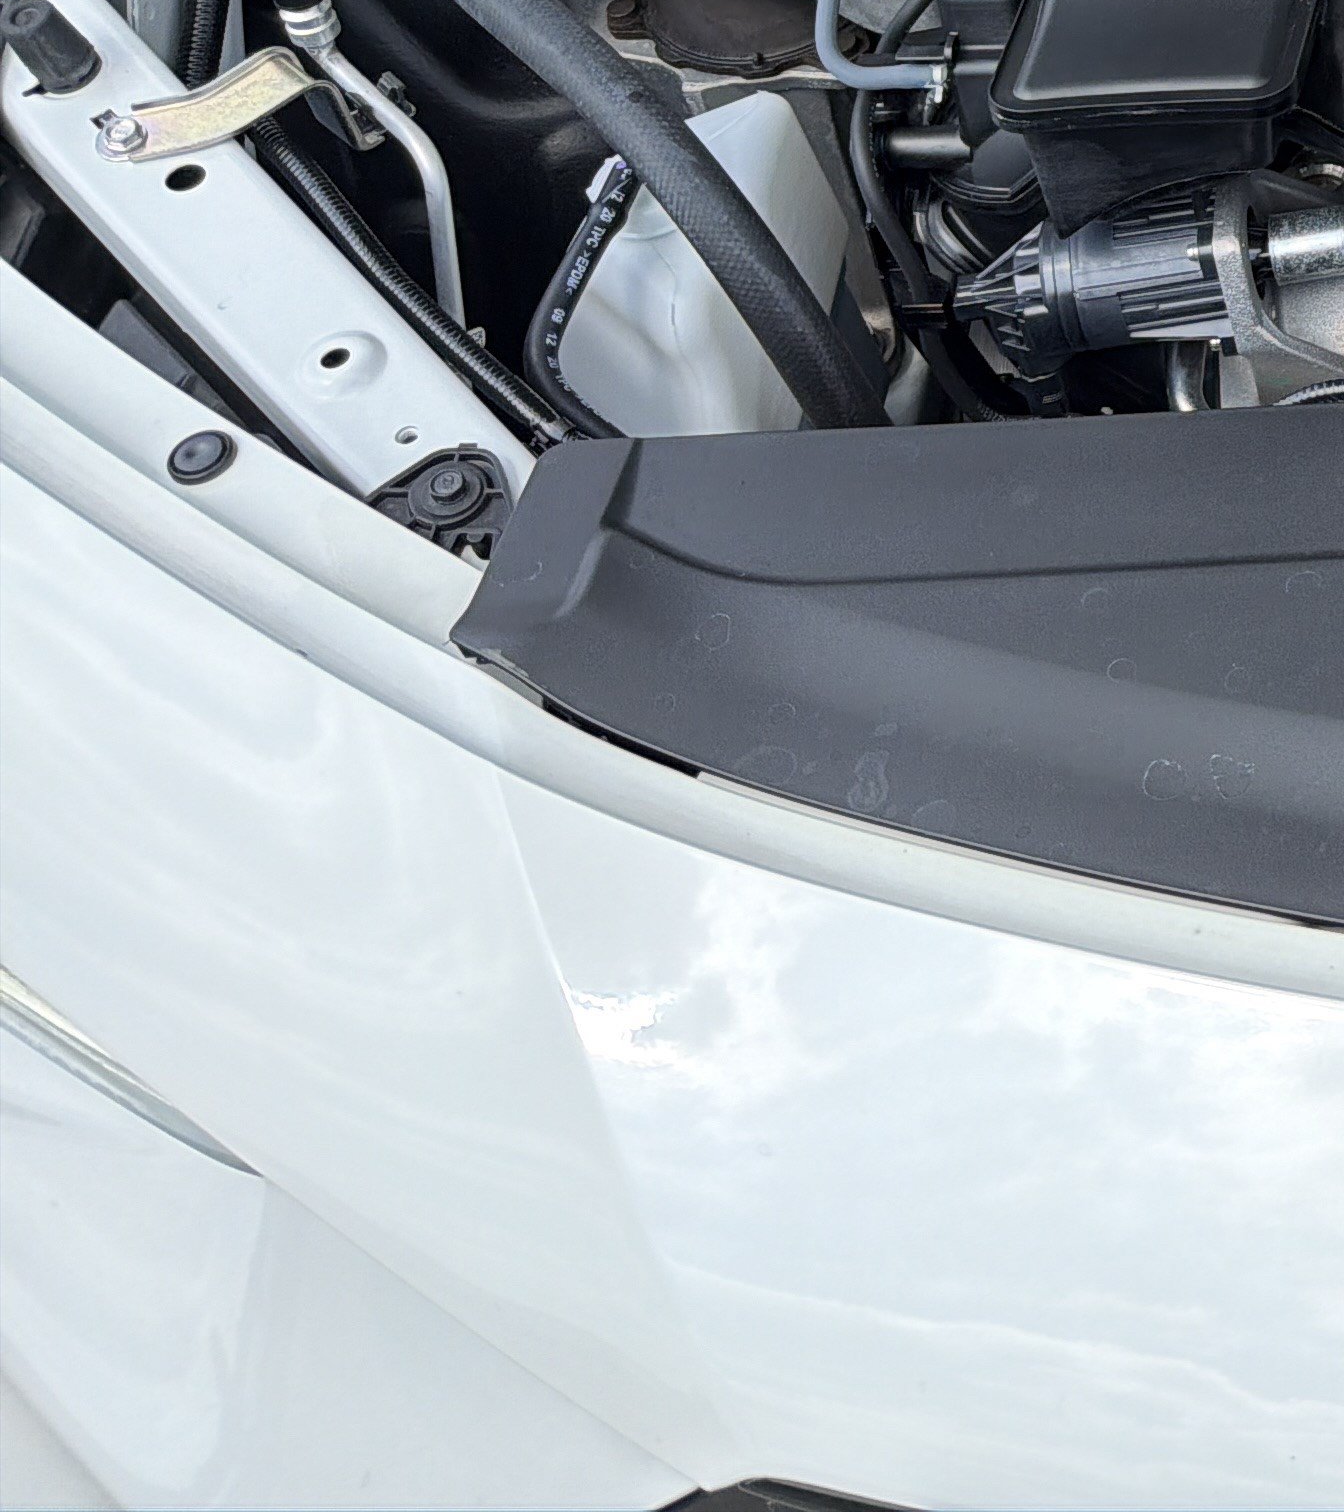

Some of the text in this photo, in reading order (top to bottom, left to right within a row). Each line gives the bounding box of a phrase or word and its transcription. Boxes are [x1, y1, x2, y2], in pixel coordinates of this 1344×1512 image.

[600, 206, 616, 224] 20
[586, 225, 607, 249] TPC
[551, 307, 566, 325] 09
[545, 332, 558, 347] 12
[546, 355, 559, 370] 20
